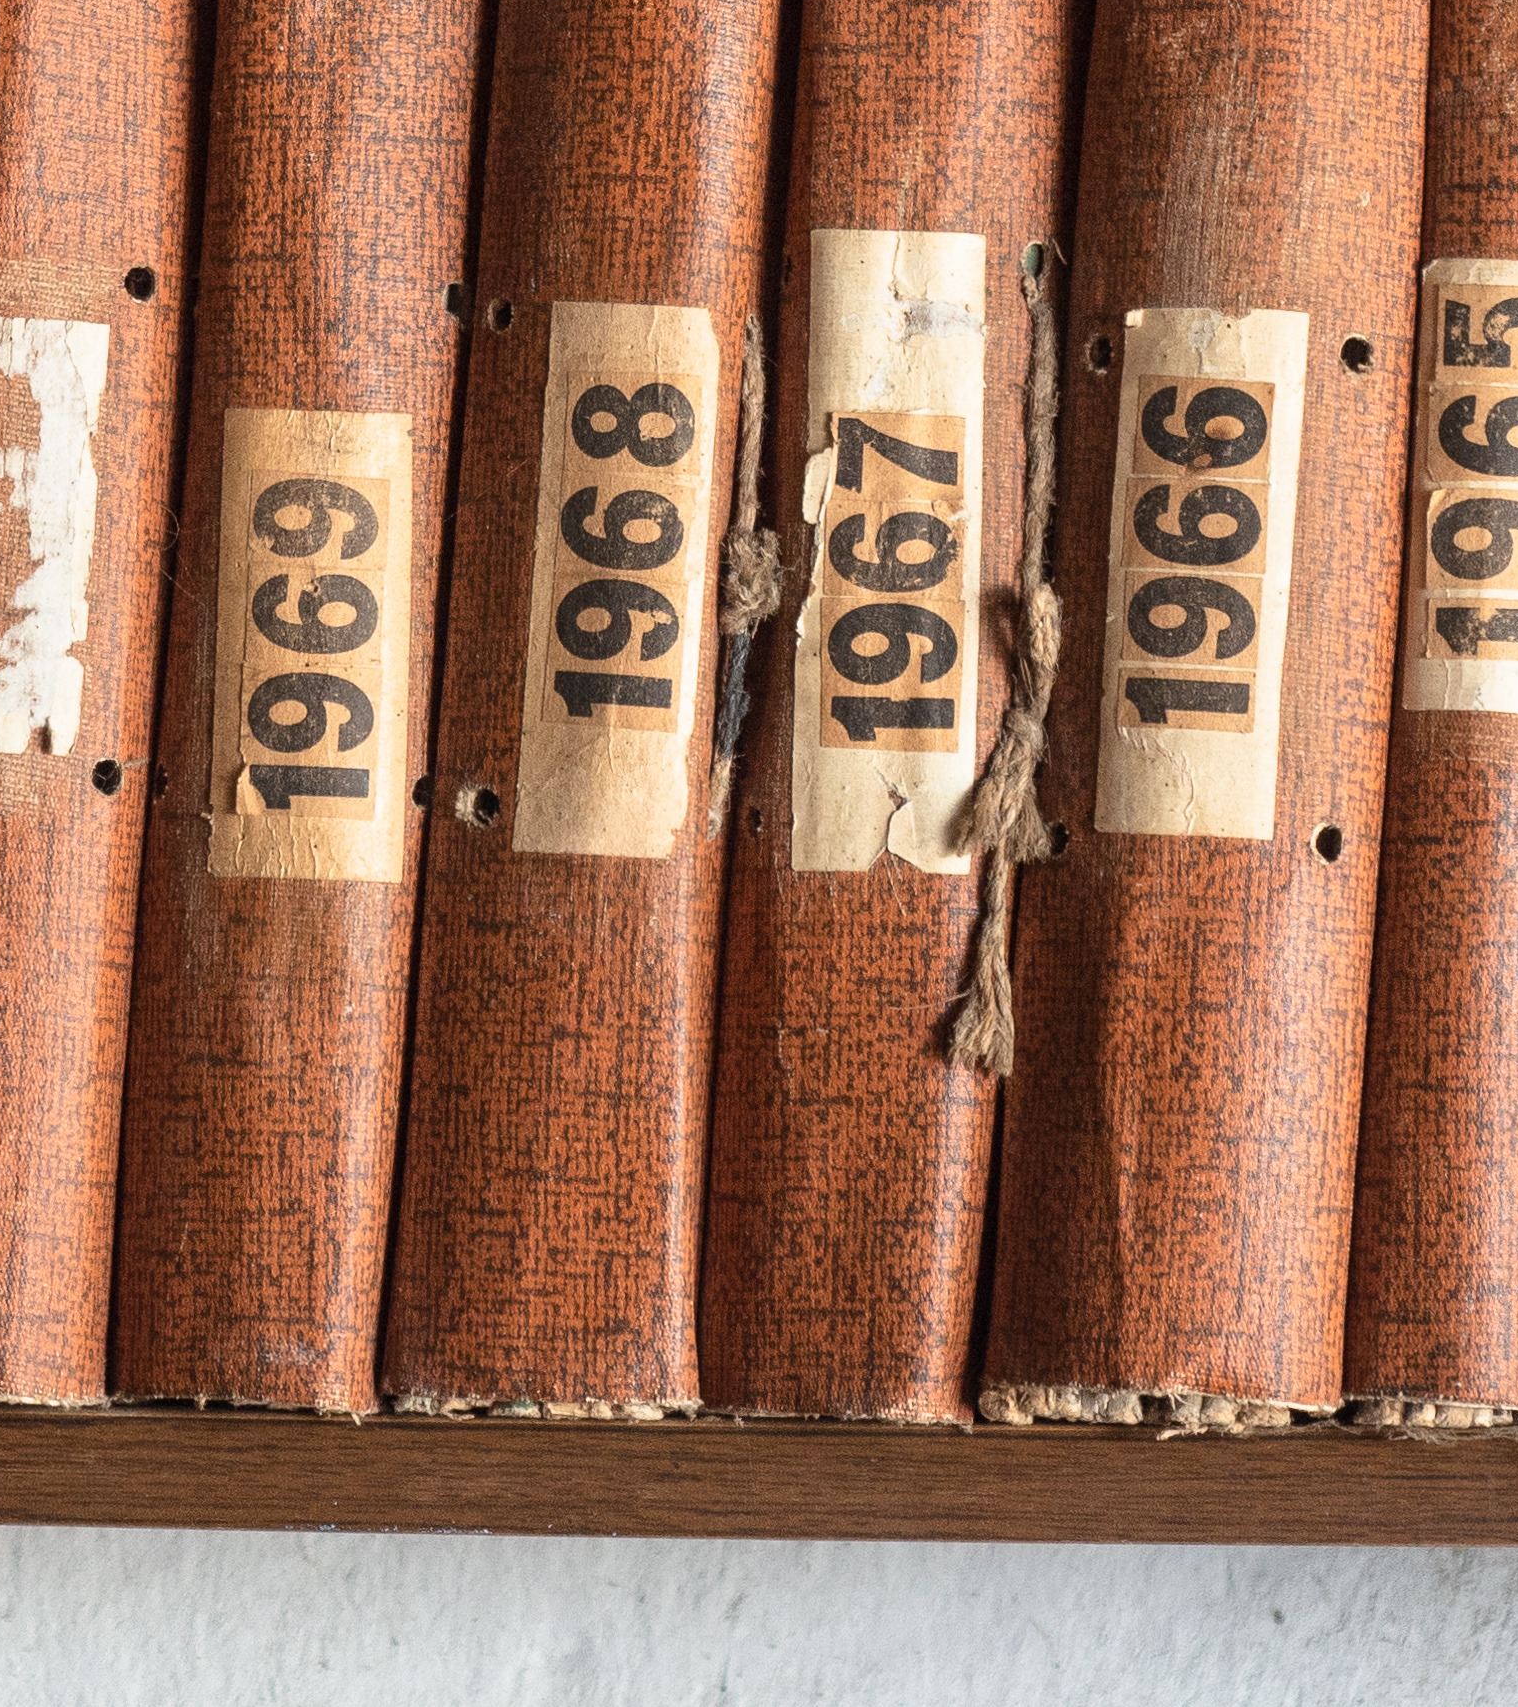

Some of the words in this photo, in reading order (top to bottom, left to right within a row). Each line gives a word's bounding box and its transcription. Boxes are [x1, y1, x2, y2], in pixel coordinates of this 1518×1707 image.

[249, 477, 378, 809] 1969
[554, 383, 695, 717] 1968
[826, 417, 958, 742] 1967
[1125, 385, 1268, 725] 1966
